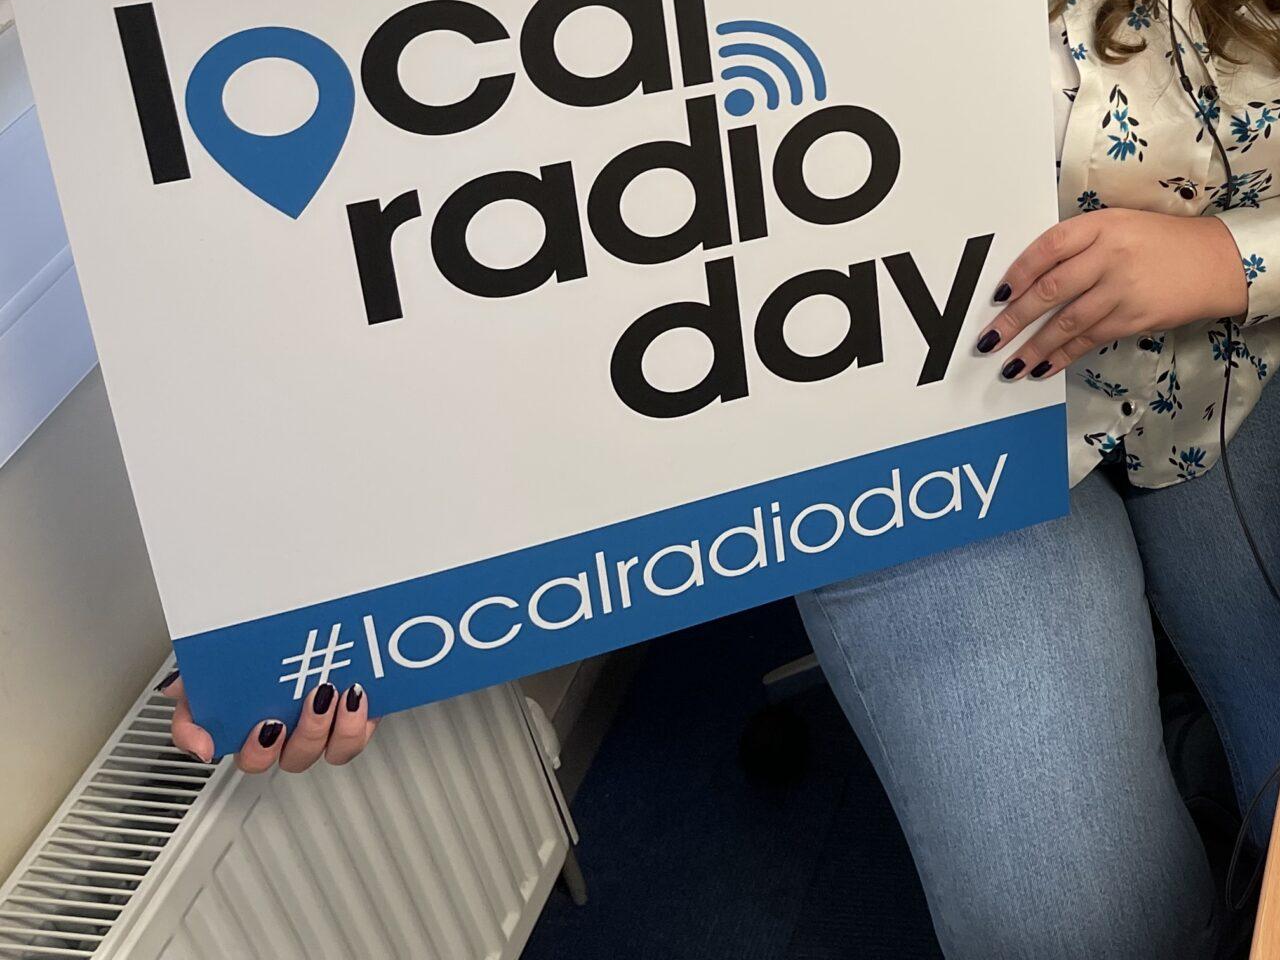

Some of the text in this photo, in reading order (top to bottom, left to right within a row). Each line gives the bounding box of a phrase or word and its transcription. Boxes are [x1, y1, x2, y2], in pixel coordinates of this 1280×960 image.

[345, 87, 901, 327] radio
[610, 232, 996, 420] day
[279, 453, 1009, 700] #localradioday
